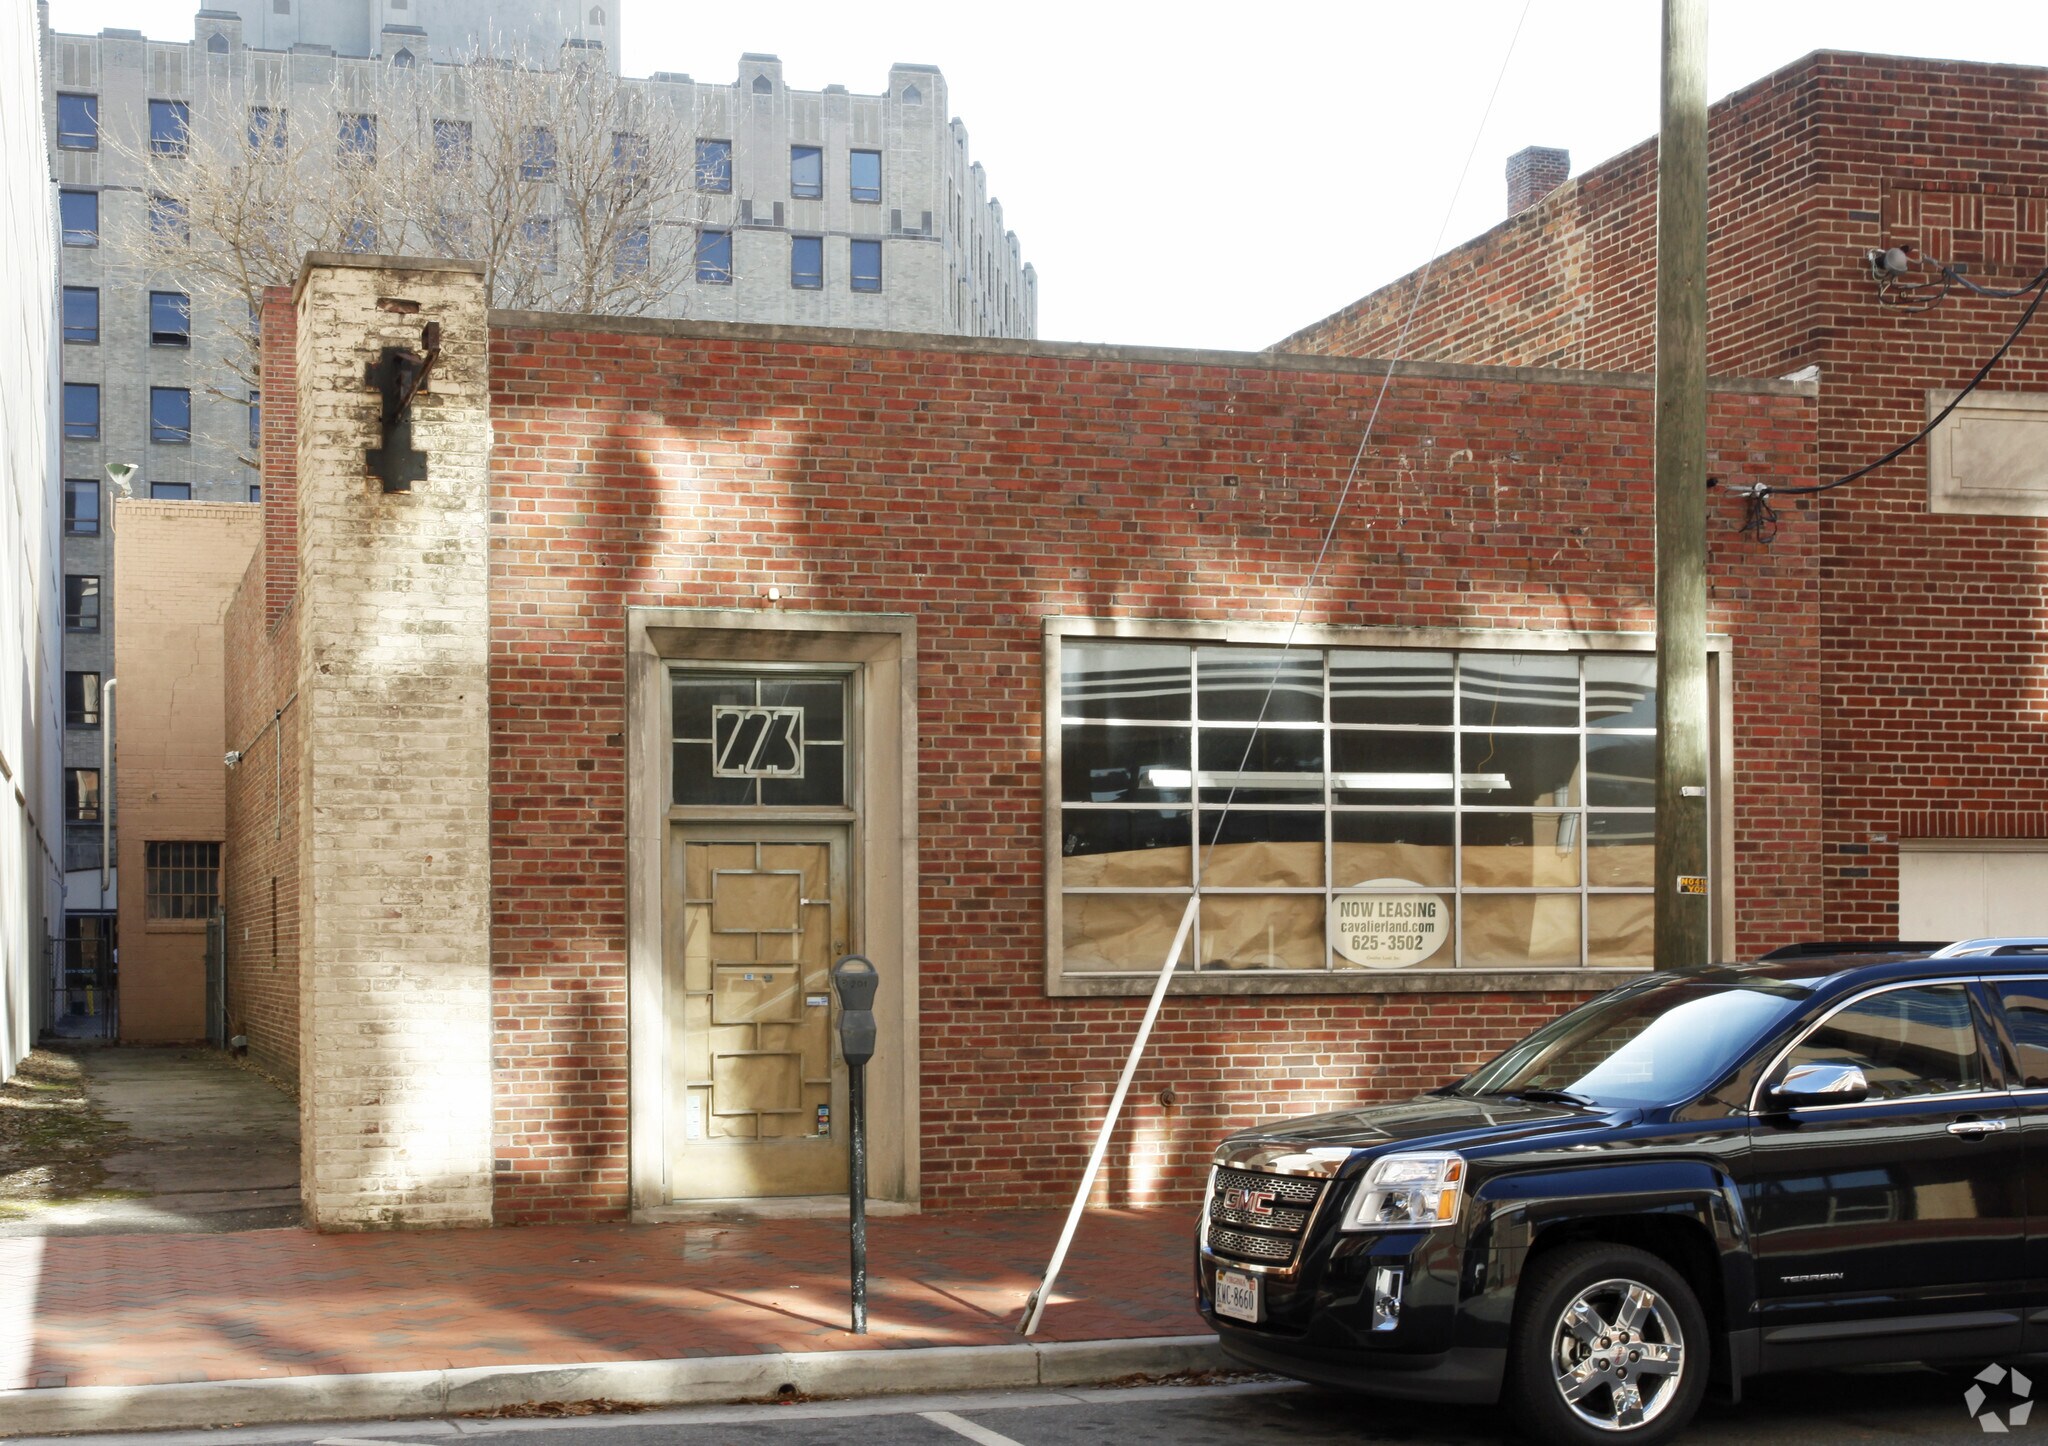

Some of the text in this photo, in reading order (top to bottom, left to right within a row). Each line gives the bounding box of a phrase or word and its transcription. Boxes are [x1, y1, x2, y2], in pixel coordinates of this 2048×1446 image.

[1340, 901, 1436, 918] NOW LEASING
[1341, 920, 1435, 933] cavalierland.com
[1351, 935, 1424, 950] 625-3502
[1224, 1188, 1276, 1215] GMC
[1780, 1272, 1844, 1283] TERRAIN
